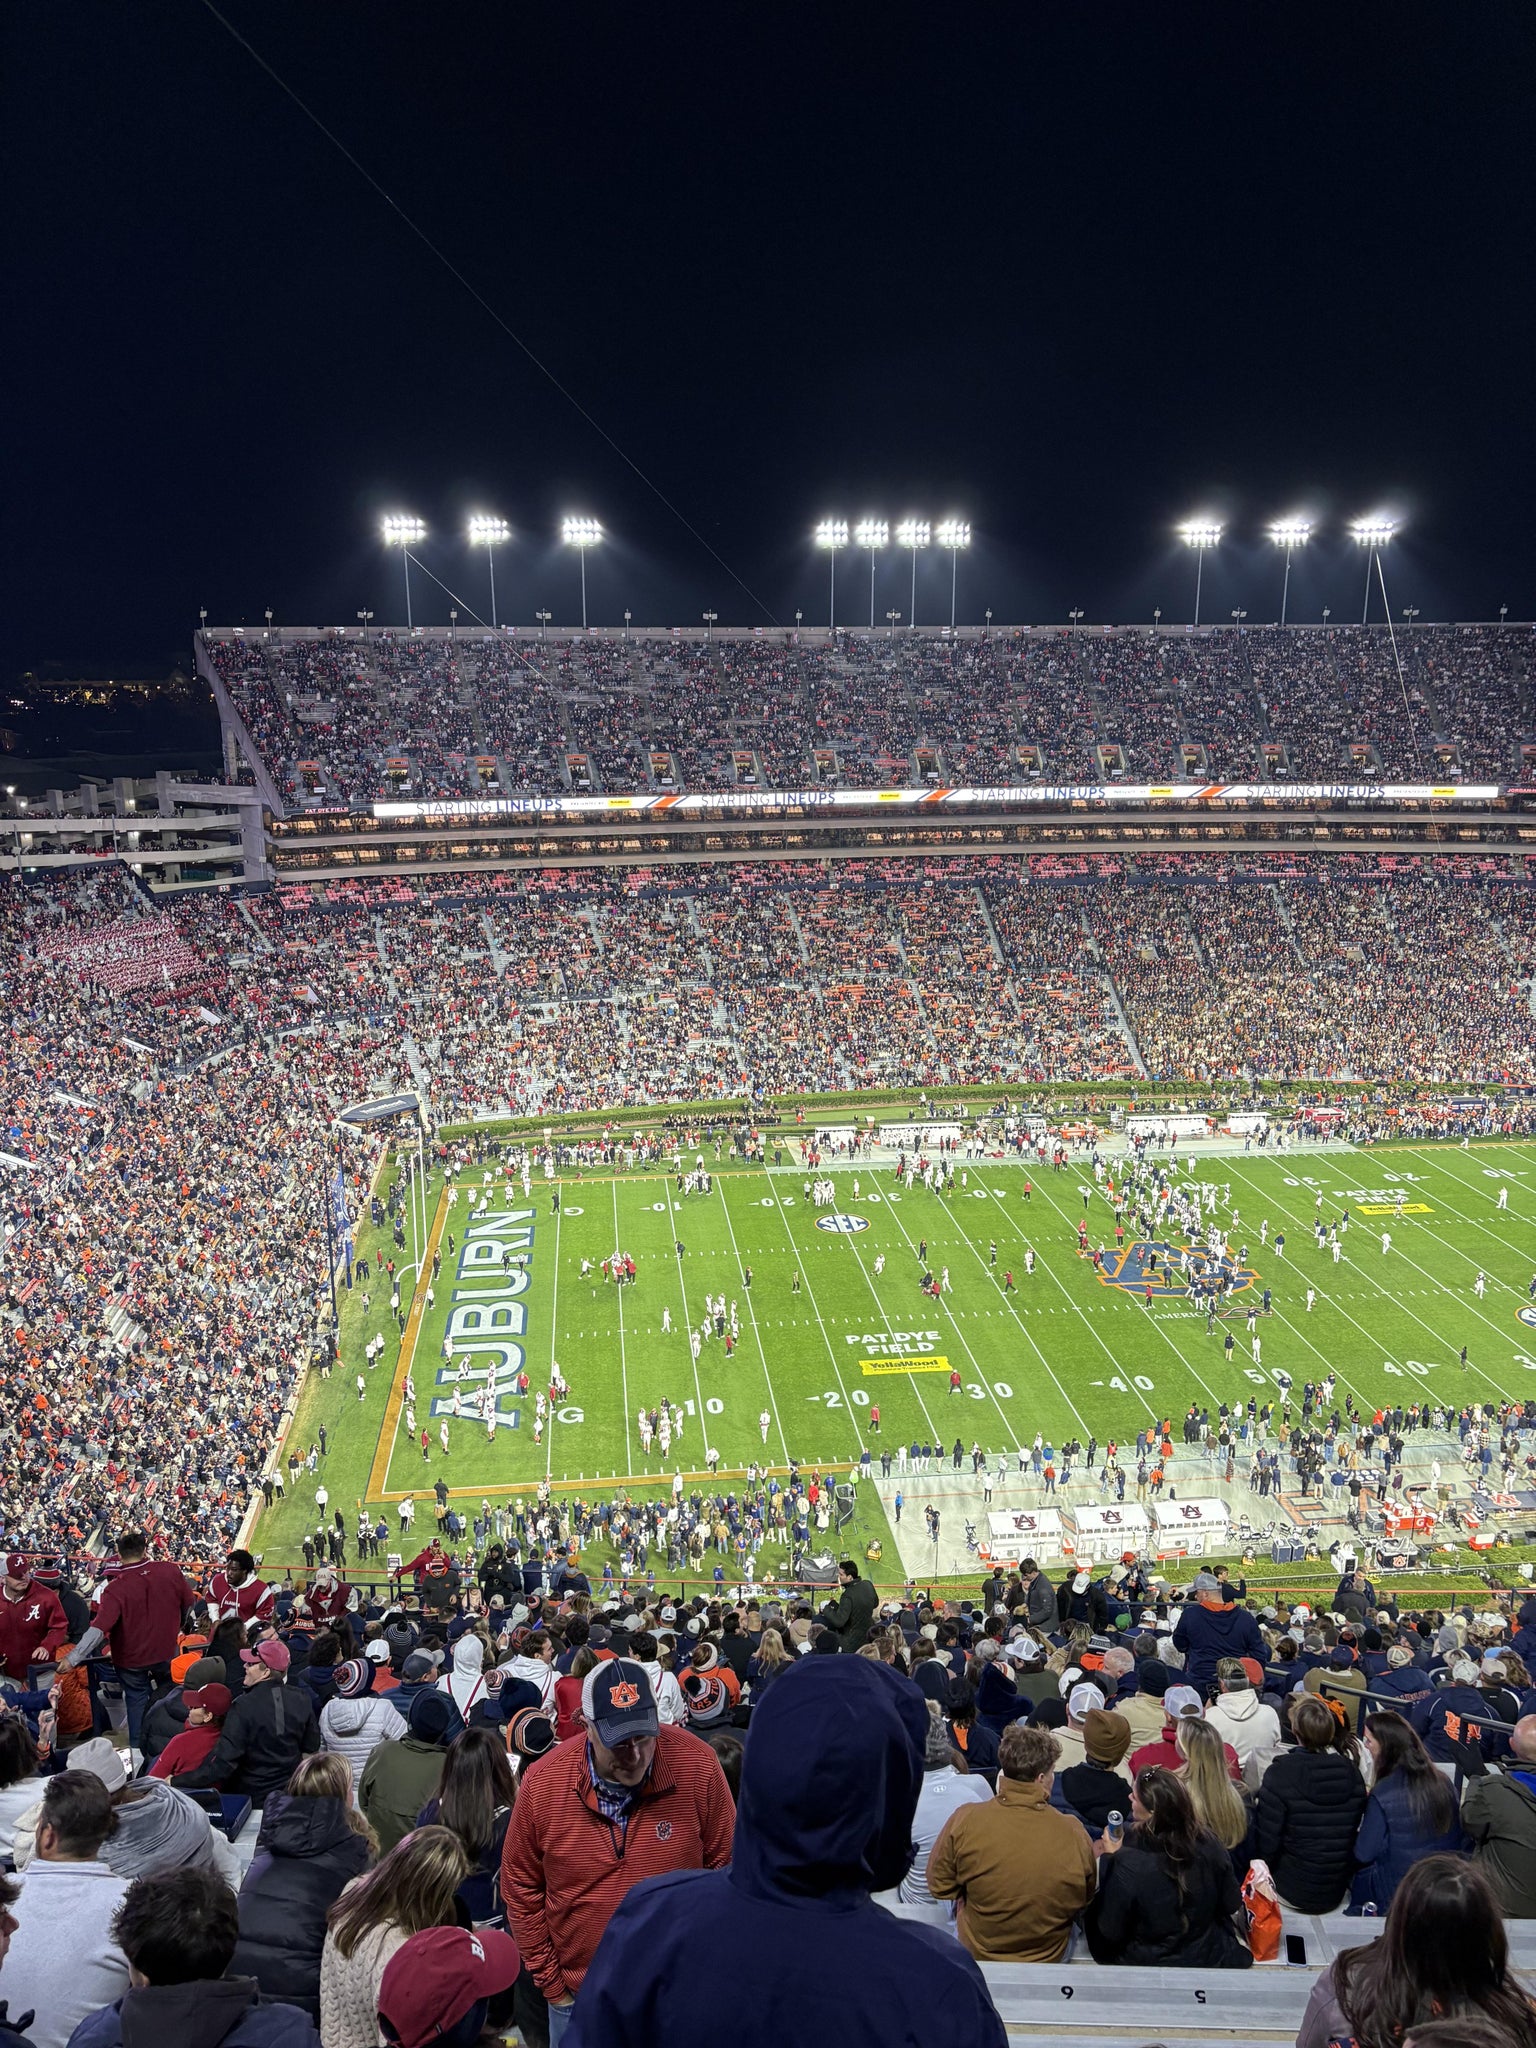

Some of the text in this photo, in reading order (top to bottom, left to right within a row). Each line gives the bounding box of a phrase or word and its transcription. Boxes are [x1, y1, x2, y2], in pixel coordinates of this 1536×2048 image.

[701, 792, 835, 807] STARTING LINEUPS
[972, 787, 1106, 800] STARTING LINEUPS
[1247, 786, 1317, 798] STARTING
[1321, 786, 1385, 797] LINEUPS
[416, 799, 563, 815] STARTING LINEUPS
[817, 1214, 870, 1233] SEC
[430, 1208, 537, 1429] AUBURN
[845, 1331, 942, 1345] PAT DYE
[866, 1342, 935, 1354] FIELD
[1243, 1367, 1293, 1384] 50
[1383, 1360, 1429, 1377] 40
[966, 1382, 1014, 1399] 30
[1109, 1375, 1155, 1392] 40
[684, 1398, 724, 1416] 10
[823, 1389, 870, 1408] 20
[556, 1407, 584, 1424] G
[25, 1604, 41, 1622] A
[609, 1681, 640, 1708] AU
[1194, 1989, 1206, 2004] 5
